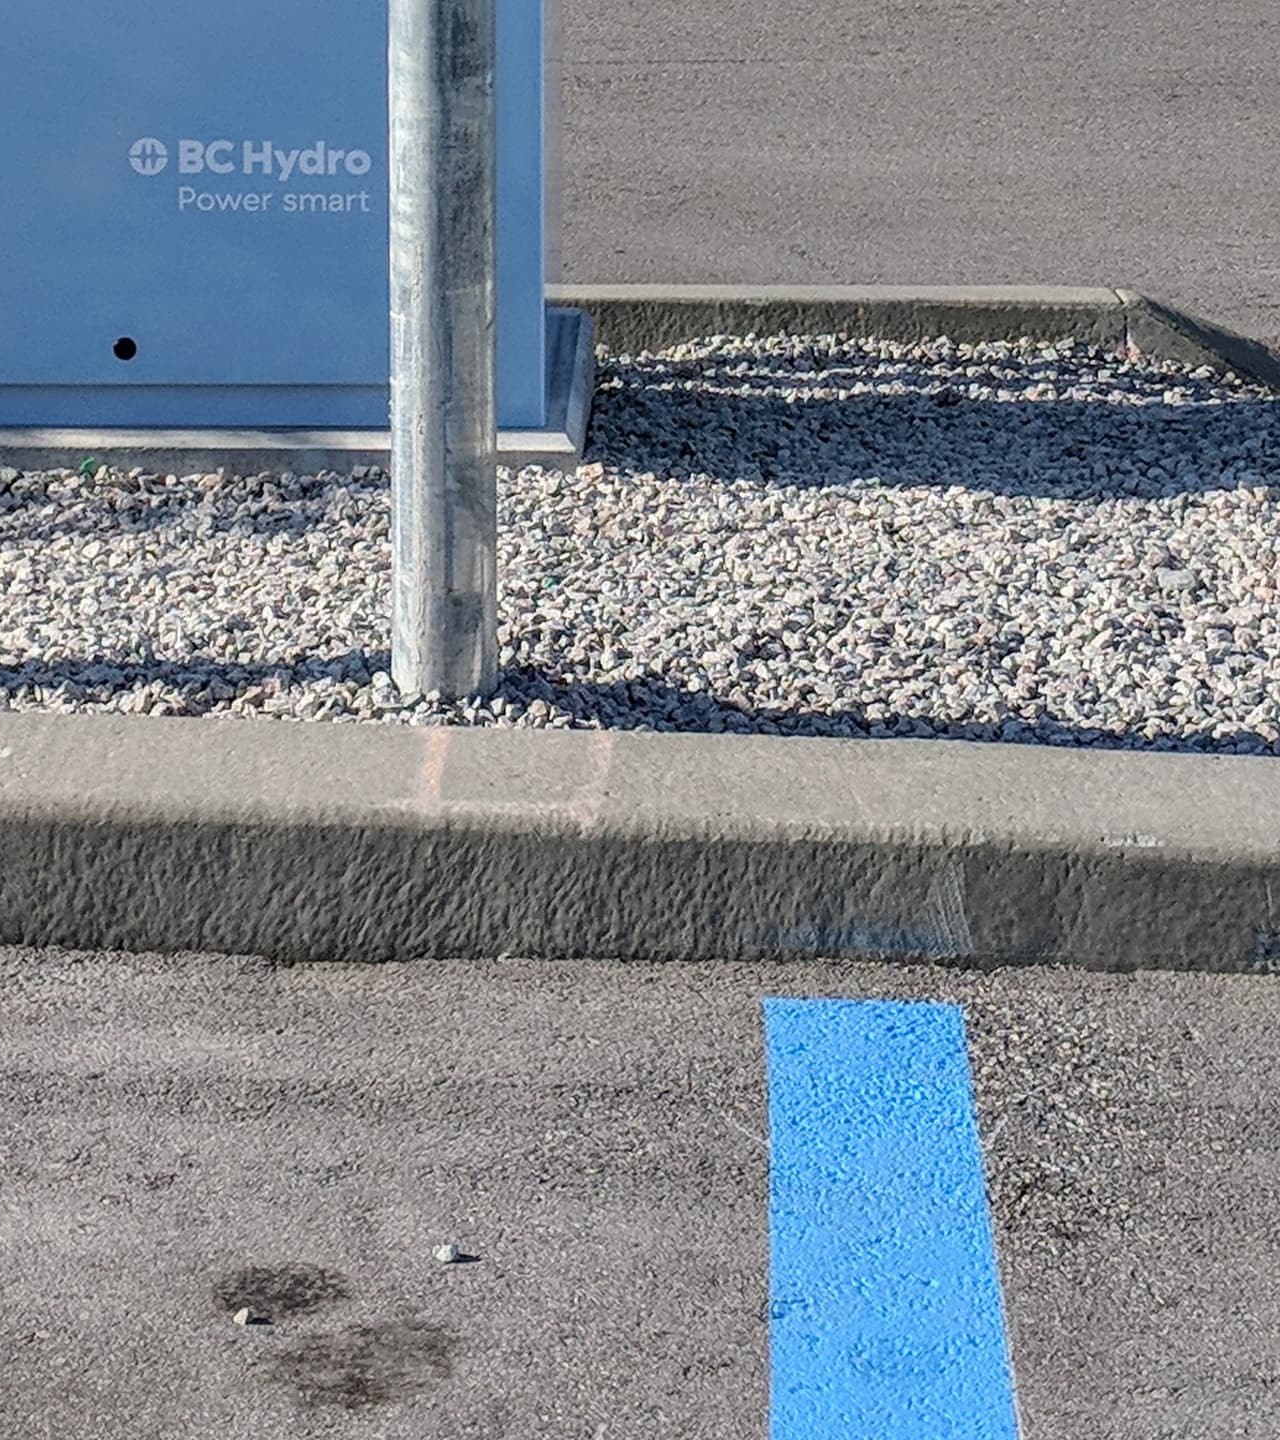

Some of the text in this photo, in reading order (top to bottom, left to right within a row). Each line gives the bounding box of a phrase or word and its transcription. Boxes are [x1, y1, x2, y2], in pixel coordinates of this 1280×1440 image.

[178, 139, 372, 182] BC Hydro
[178, 186, 370, 212] Power smart
